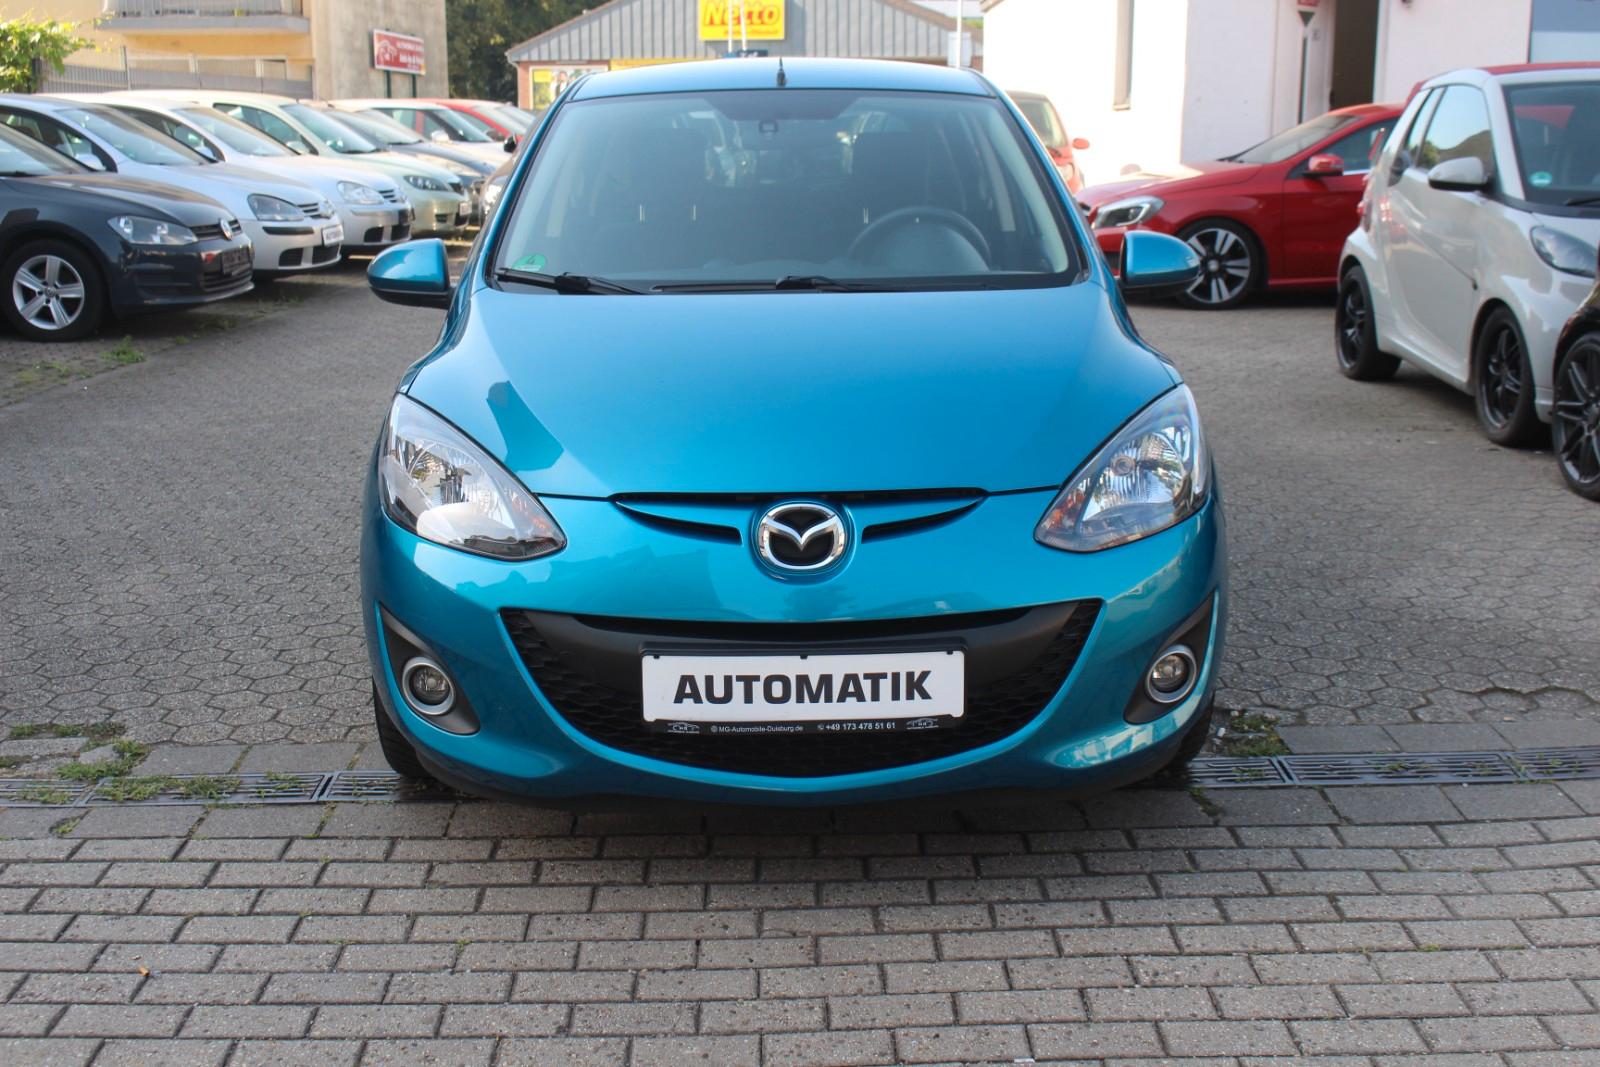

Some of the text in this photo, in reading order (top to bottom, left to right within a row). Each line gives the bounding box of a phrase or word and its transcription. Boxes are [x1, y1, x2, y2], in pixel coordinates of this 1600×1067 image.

[704, 1, 780, 26] Netto
[673, 670, 932, 705] AUTOMATIK
[825, 723, 840, 732] +49
[842, 723, 856, 732] 173
[858, 722, 873, 731] 478
[874, 722, 884, 731] 51
